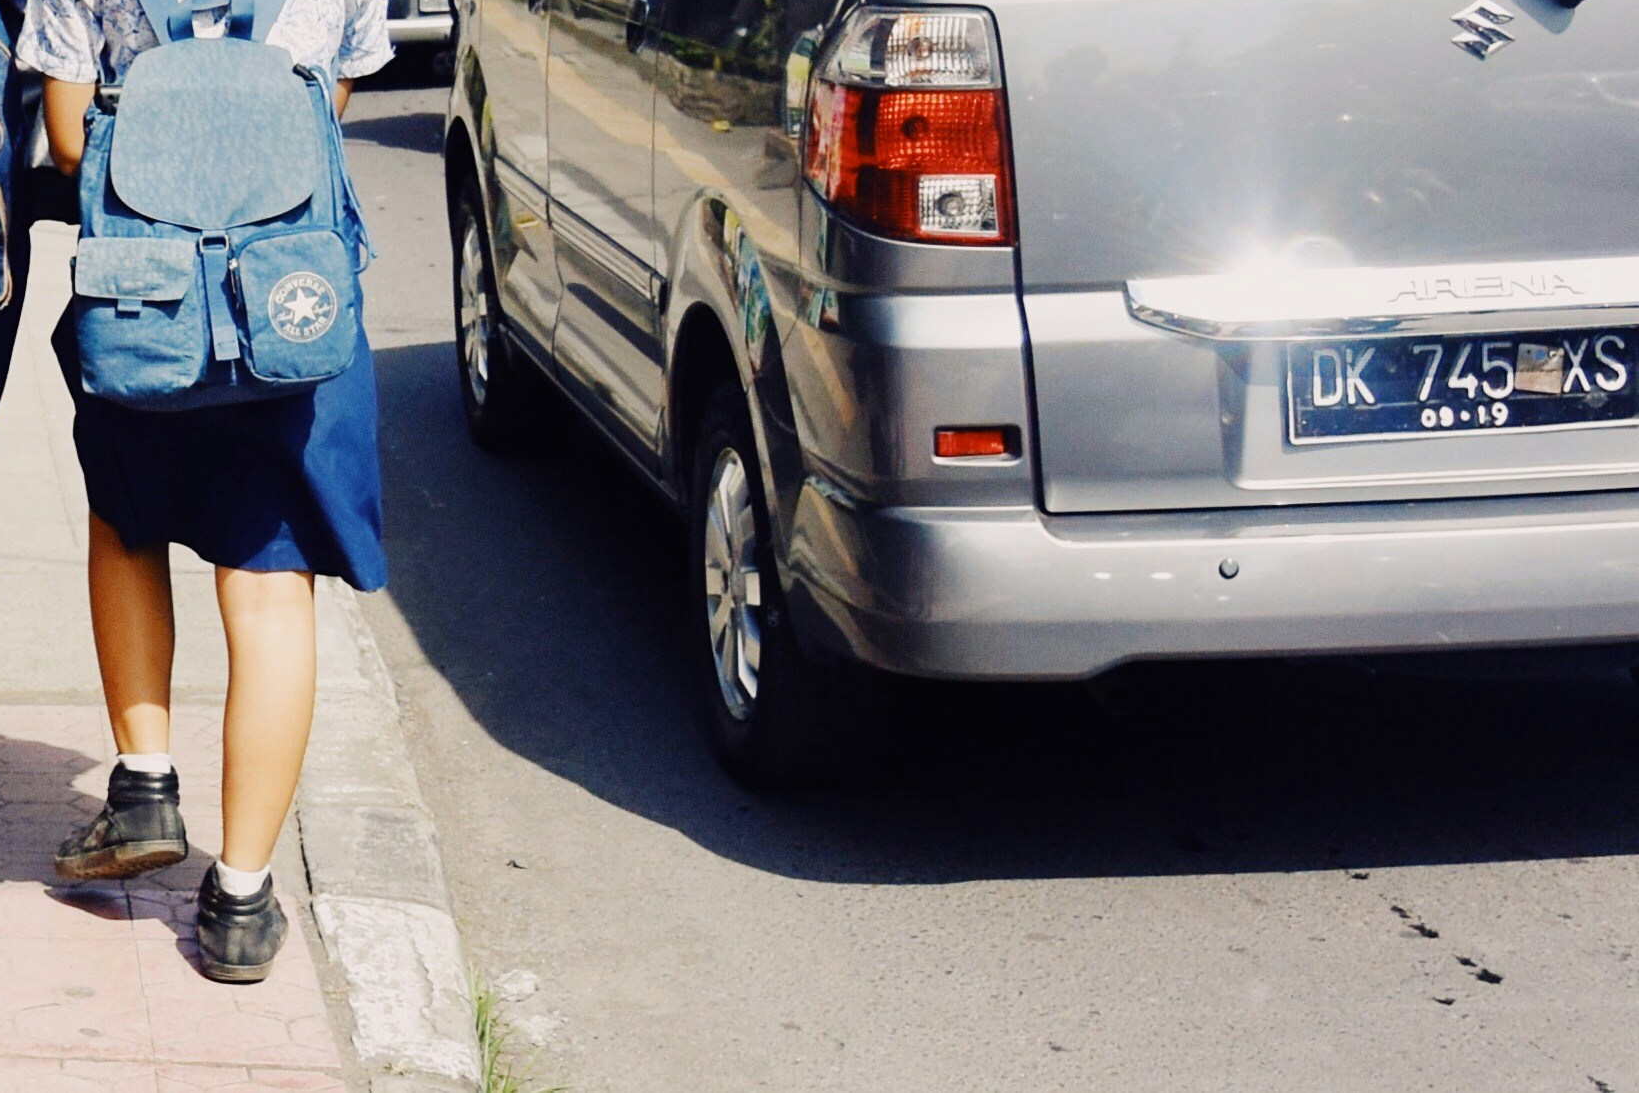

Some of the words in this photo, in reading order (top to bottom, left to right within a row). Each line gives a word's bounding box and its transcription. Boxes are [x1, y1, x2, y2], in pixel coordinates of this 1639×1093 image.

[275, 278, 326, 304] CONVERSE
[1388, 274, 1586, 303] ARENA
[281, 323, 301, 336] ALL
[303, 316, 327, 336] STAR
[1312, 346, 1376, 408] DK
[1563, 333, 1627, 393] XS
